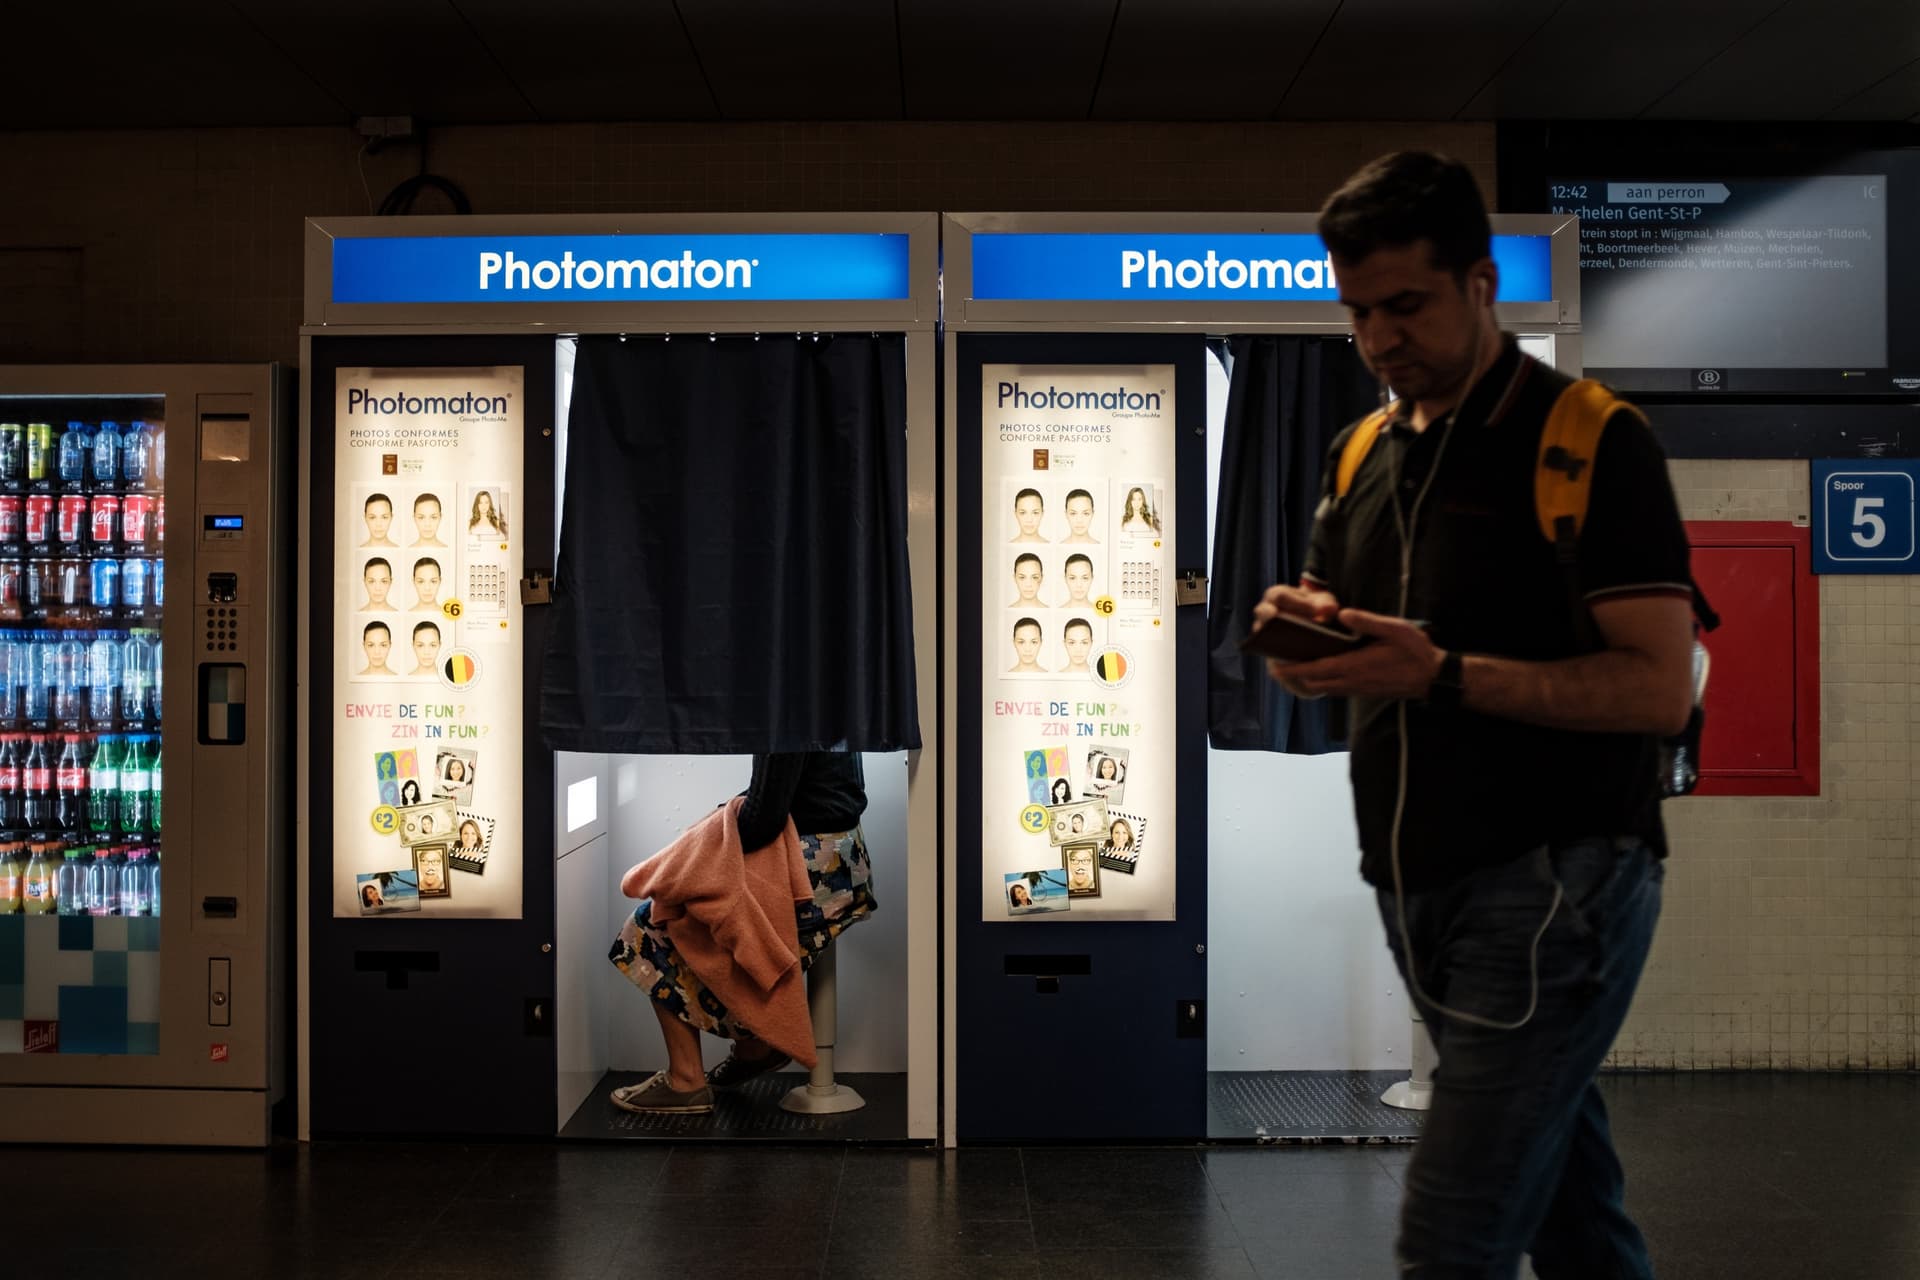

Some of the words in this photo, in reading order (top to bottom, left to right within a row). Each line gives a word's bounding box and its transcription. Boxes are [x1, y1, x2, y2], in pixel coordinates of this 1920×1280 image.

[1552, 185, 1587, 199] 12:42
[1626, 188, 1652, 199] aan
[1657, 188, 1705, 201] perron
[1863, 185, 1878, 199] IC
[1552, 205, 1623, 220] Mchelen
[1628, 205, 1702, 220] Gent-St-P
[1581, 228, 1607, 238] trein
[1610, 229, 1638, 240] stopt
[1642, 228, 1652, 238] in
[1661, 228, 1713, 241] Wijgmaal,
[1597, 243, 1683, 254] Boortmeerbeek,
[1122, 249, 1336, 289] Photomat
[1580, 258, 1615, 270] erzeel,
[1618, 258, 1698, 270] Dendermonde,
[349, 389, 507, 415] Photomaton
[998, 382, 1161, 410] Photomaton
[350, 429, 391, 438] PHOTOS
[394, 429, 459, 438] CONFORMES
[1000, 423, 1041, 432] PHOTOS
[1046, 424, 1112, 433] CONFORMES
[350, 439, 405, 448] CONFORME
[408, 439, 459, 448] PASFOTO'S
[1000, 433, 1055, 442] CONFORME
[1058, 434, 1111, 443] PASFOTO'S
[1834, 481, 1865, 492] Spoor
[1851, 497, 1886, 548] 5
[345, 703, 393, 718] ENVIE
[399, 704, 418, 718] DE
[994, 701, 1043, 716] ENVIE
[1050, 702, 1069, 716] DE
[391, 725, 418, 738] ZIN
[425, 725, 442, 738] IN
[1041, 723, 1069, 736] ZIN
[1076, 723, 1093, 736] IN
[376, 812, 393, 829] €2
[1025, 811, 1043, 828] €2
